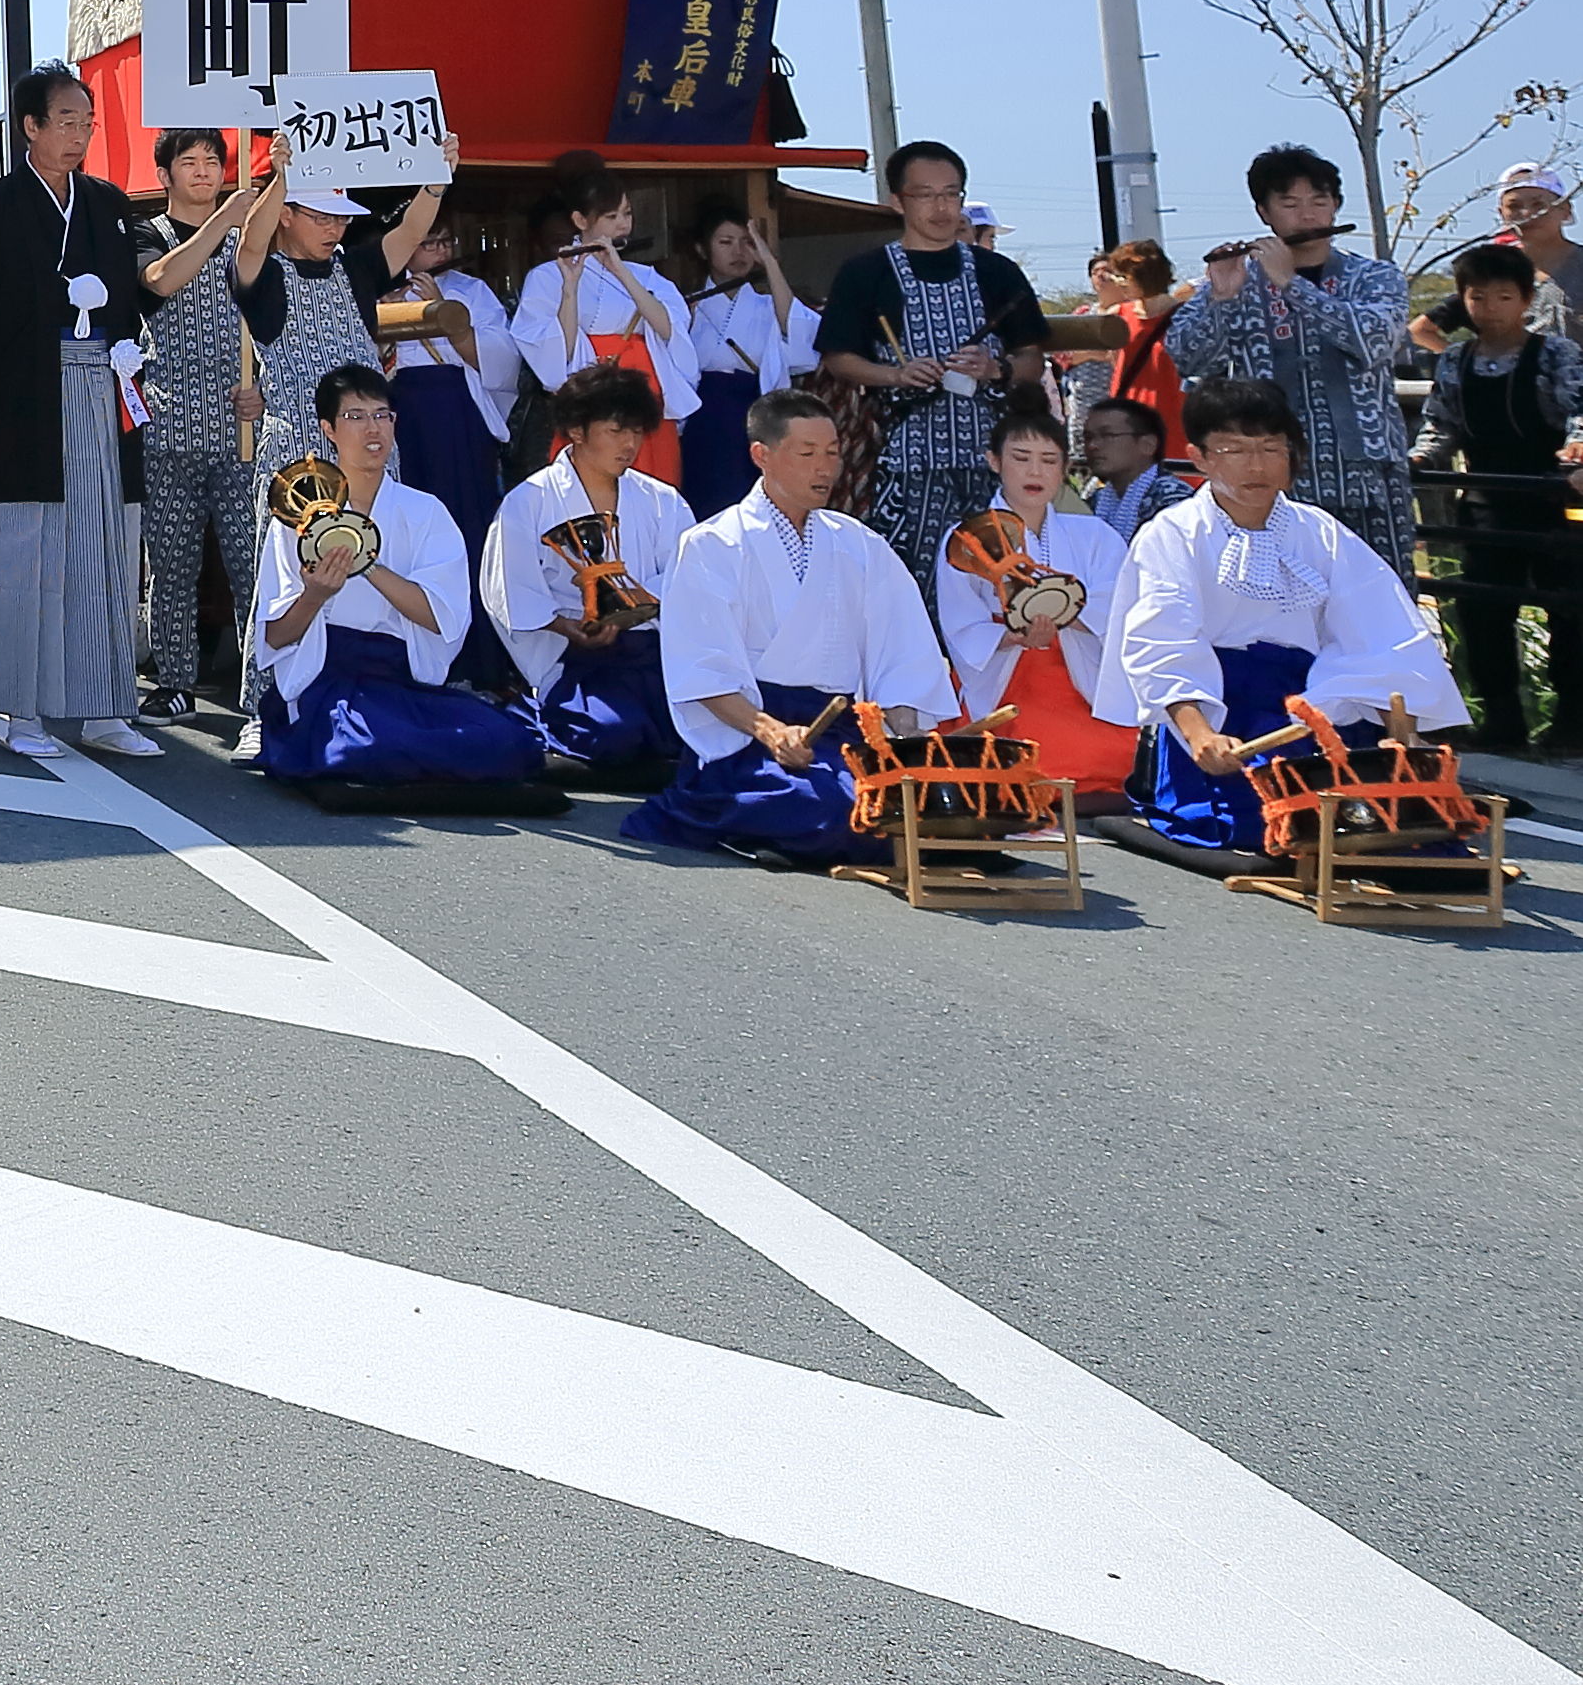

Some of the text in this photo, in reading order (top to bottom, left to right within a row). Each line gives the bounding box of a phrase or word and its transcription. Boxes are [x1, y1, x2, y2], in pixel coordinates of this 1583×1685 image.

[628, 60, 653, 114] 本町
[283, 97, 442, 152] 初出羽
